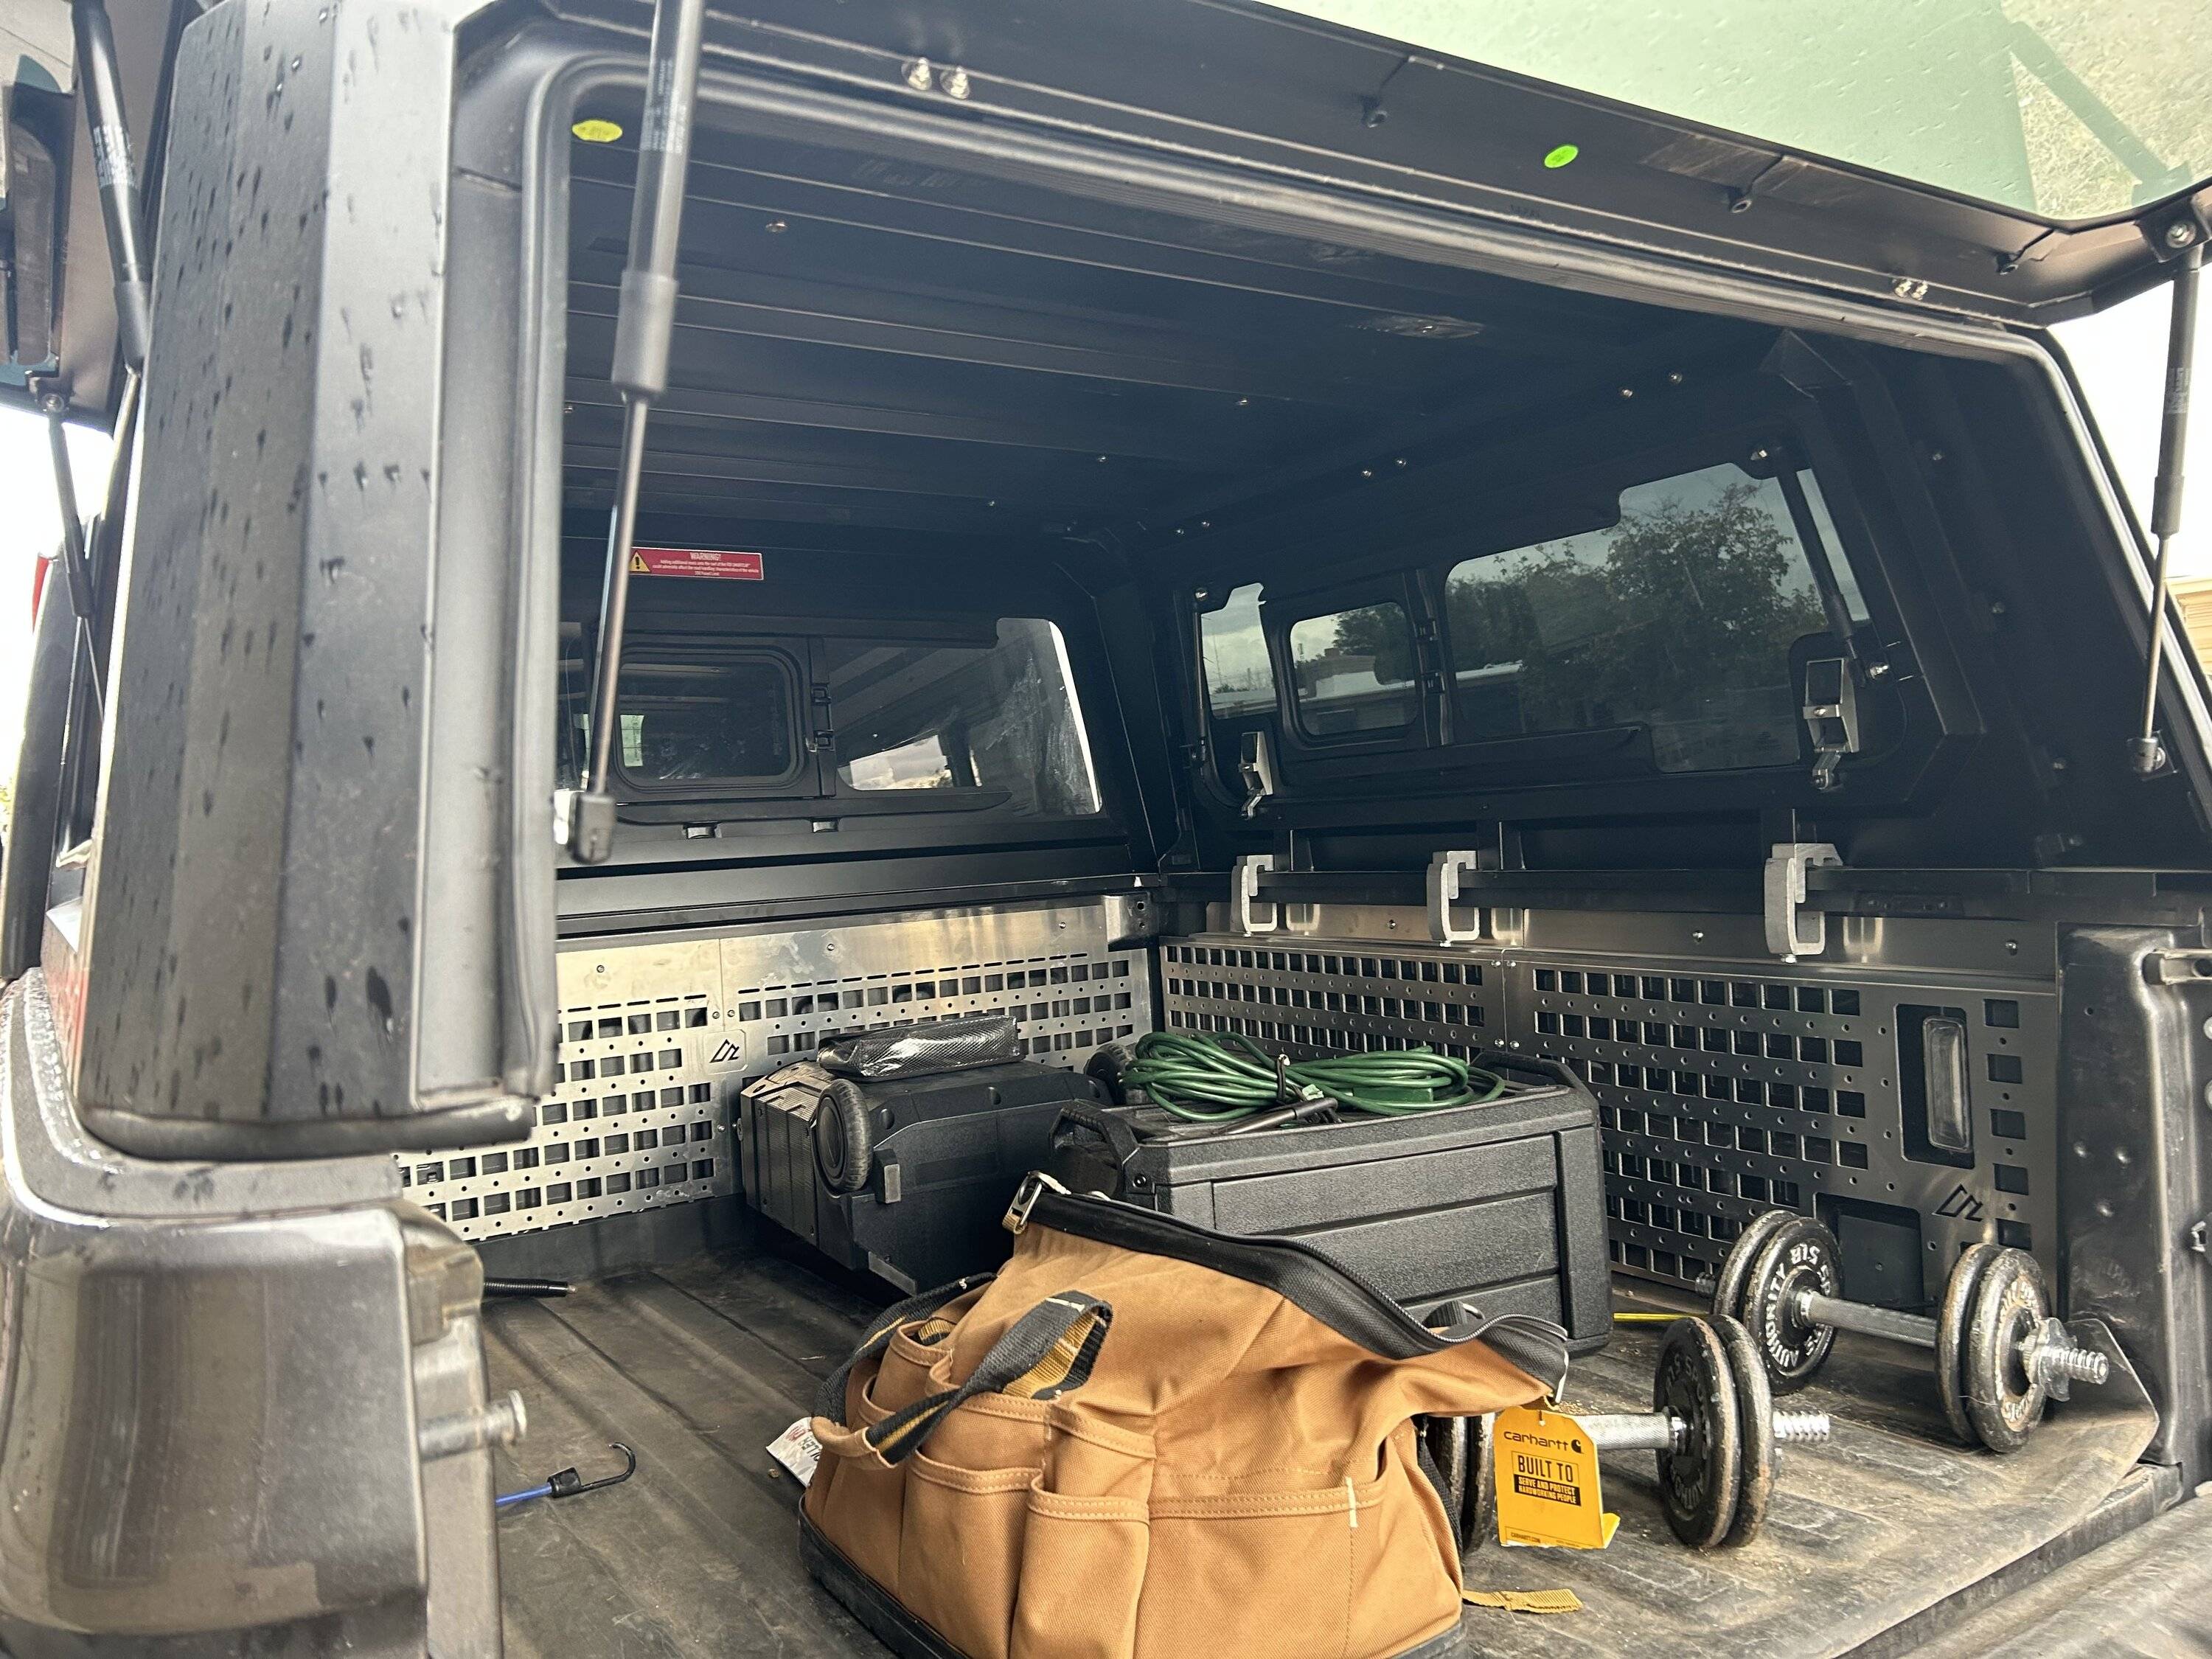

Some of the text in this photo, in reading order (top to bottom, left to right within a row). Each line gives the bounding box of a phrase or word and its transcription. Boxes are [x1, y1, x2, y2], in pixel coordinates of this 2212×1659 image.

[1764, 1262, 1799, 1368] AUTHORITY
[1503, 1430, 1569, 1451] carhartt
[1517, 1455, 1573, 1483] BUILT TO
[1518, 1477, 1576, 1496] SERVE AND PROTECT
[1518, 1485, 1577, 1503] HARDWORKING PEOPLE
